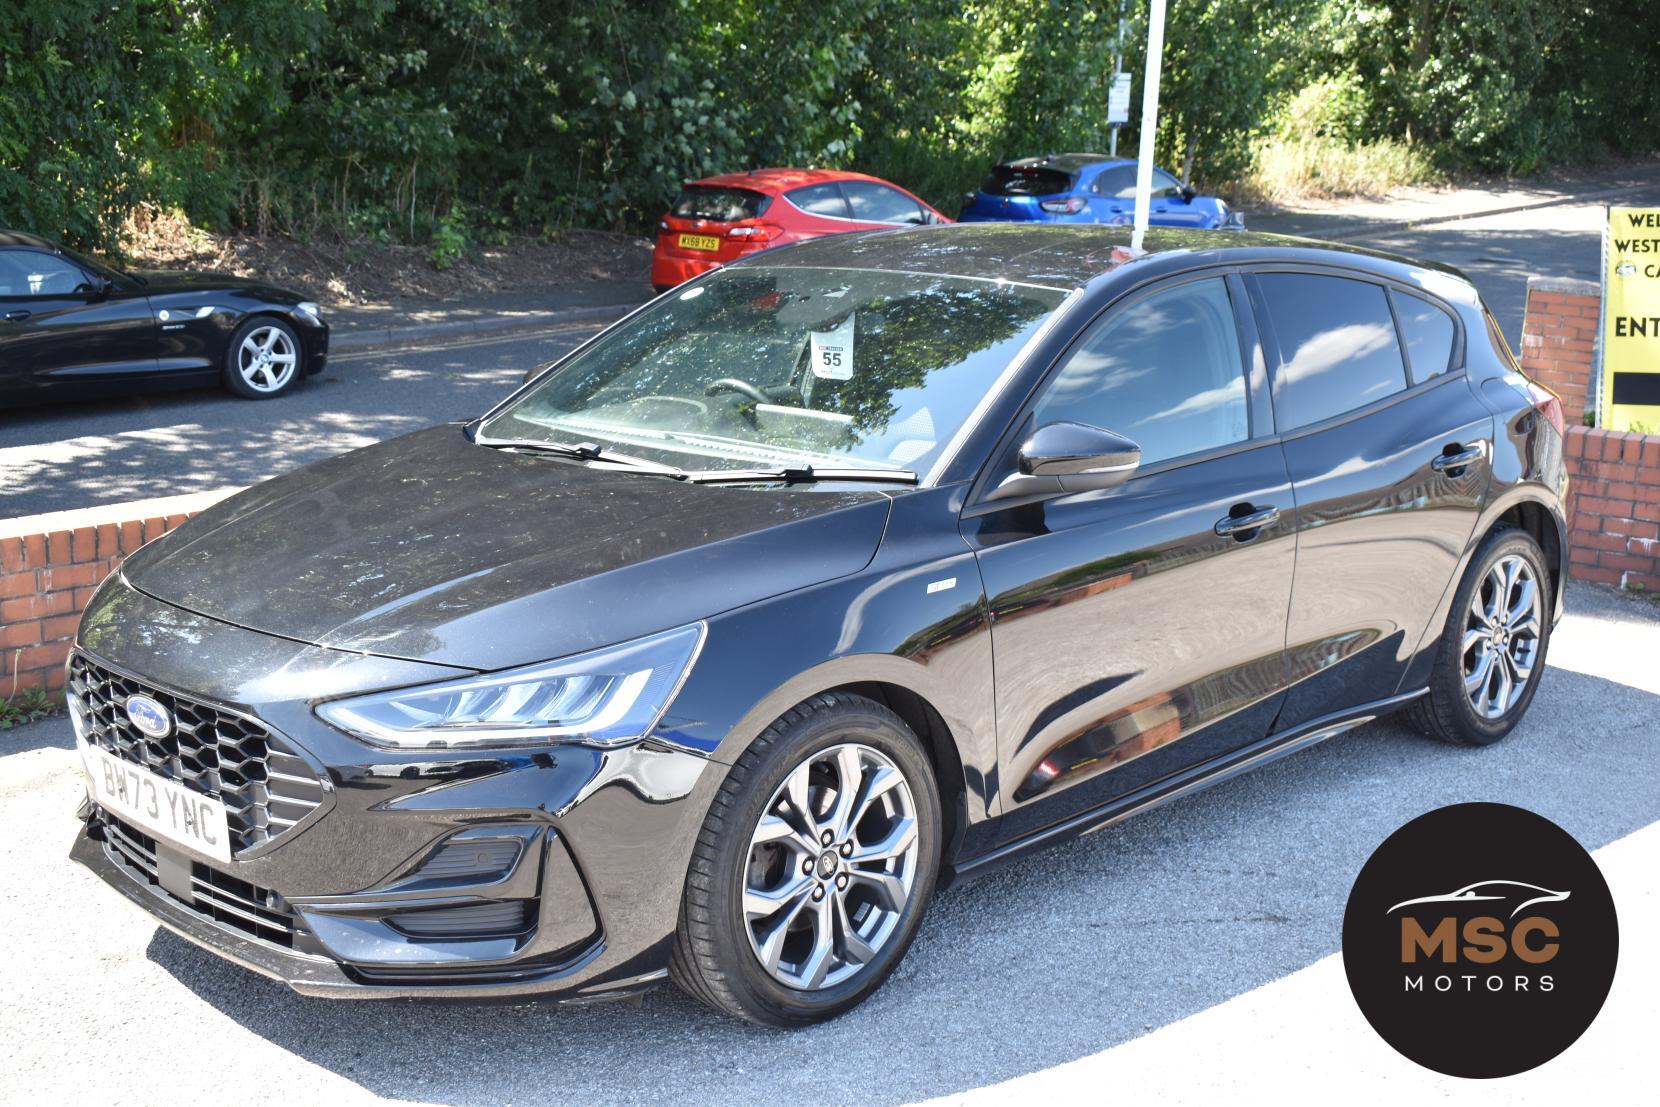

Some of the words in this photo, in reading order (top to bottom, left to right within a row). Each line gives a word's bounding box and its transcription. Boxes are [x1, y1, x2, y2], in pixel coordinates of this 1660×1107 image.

[1614, 239, 1660, 253] WEST
[1615, 316, 1660, 338] ENT
[822, 351, 842, 367] 55
[135, 703, 157, 729] Ford
[101, 756, 160, 820] BW73
[164, 786, 217, 846] YNC
